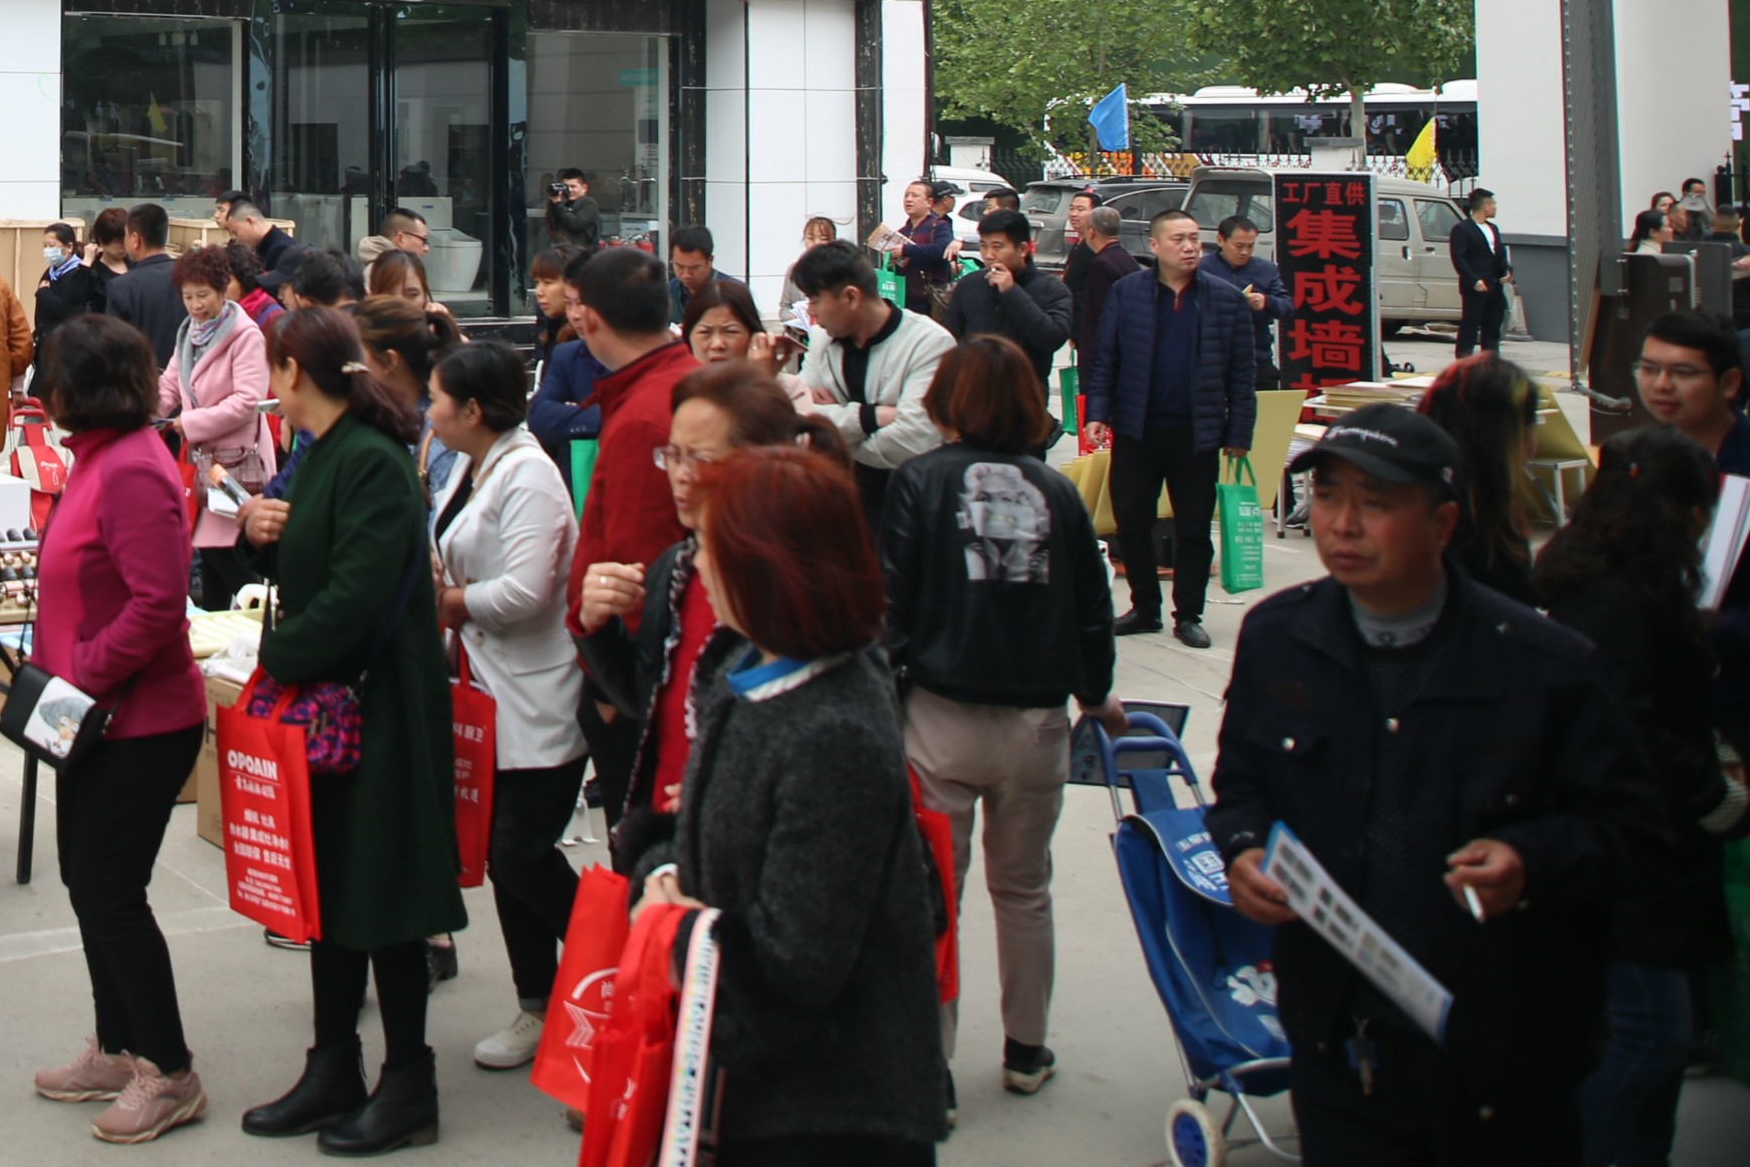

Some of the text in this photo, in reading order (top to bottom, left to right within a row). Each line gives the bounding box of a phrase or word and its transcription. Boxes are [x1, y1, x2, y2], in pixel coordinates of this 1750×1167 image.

[1281, 181, 1366, 206] 工厂直供
[227, 748, 279, 782] OPOAIN
